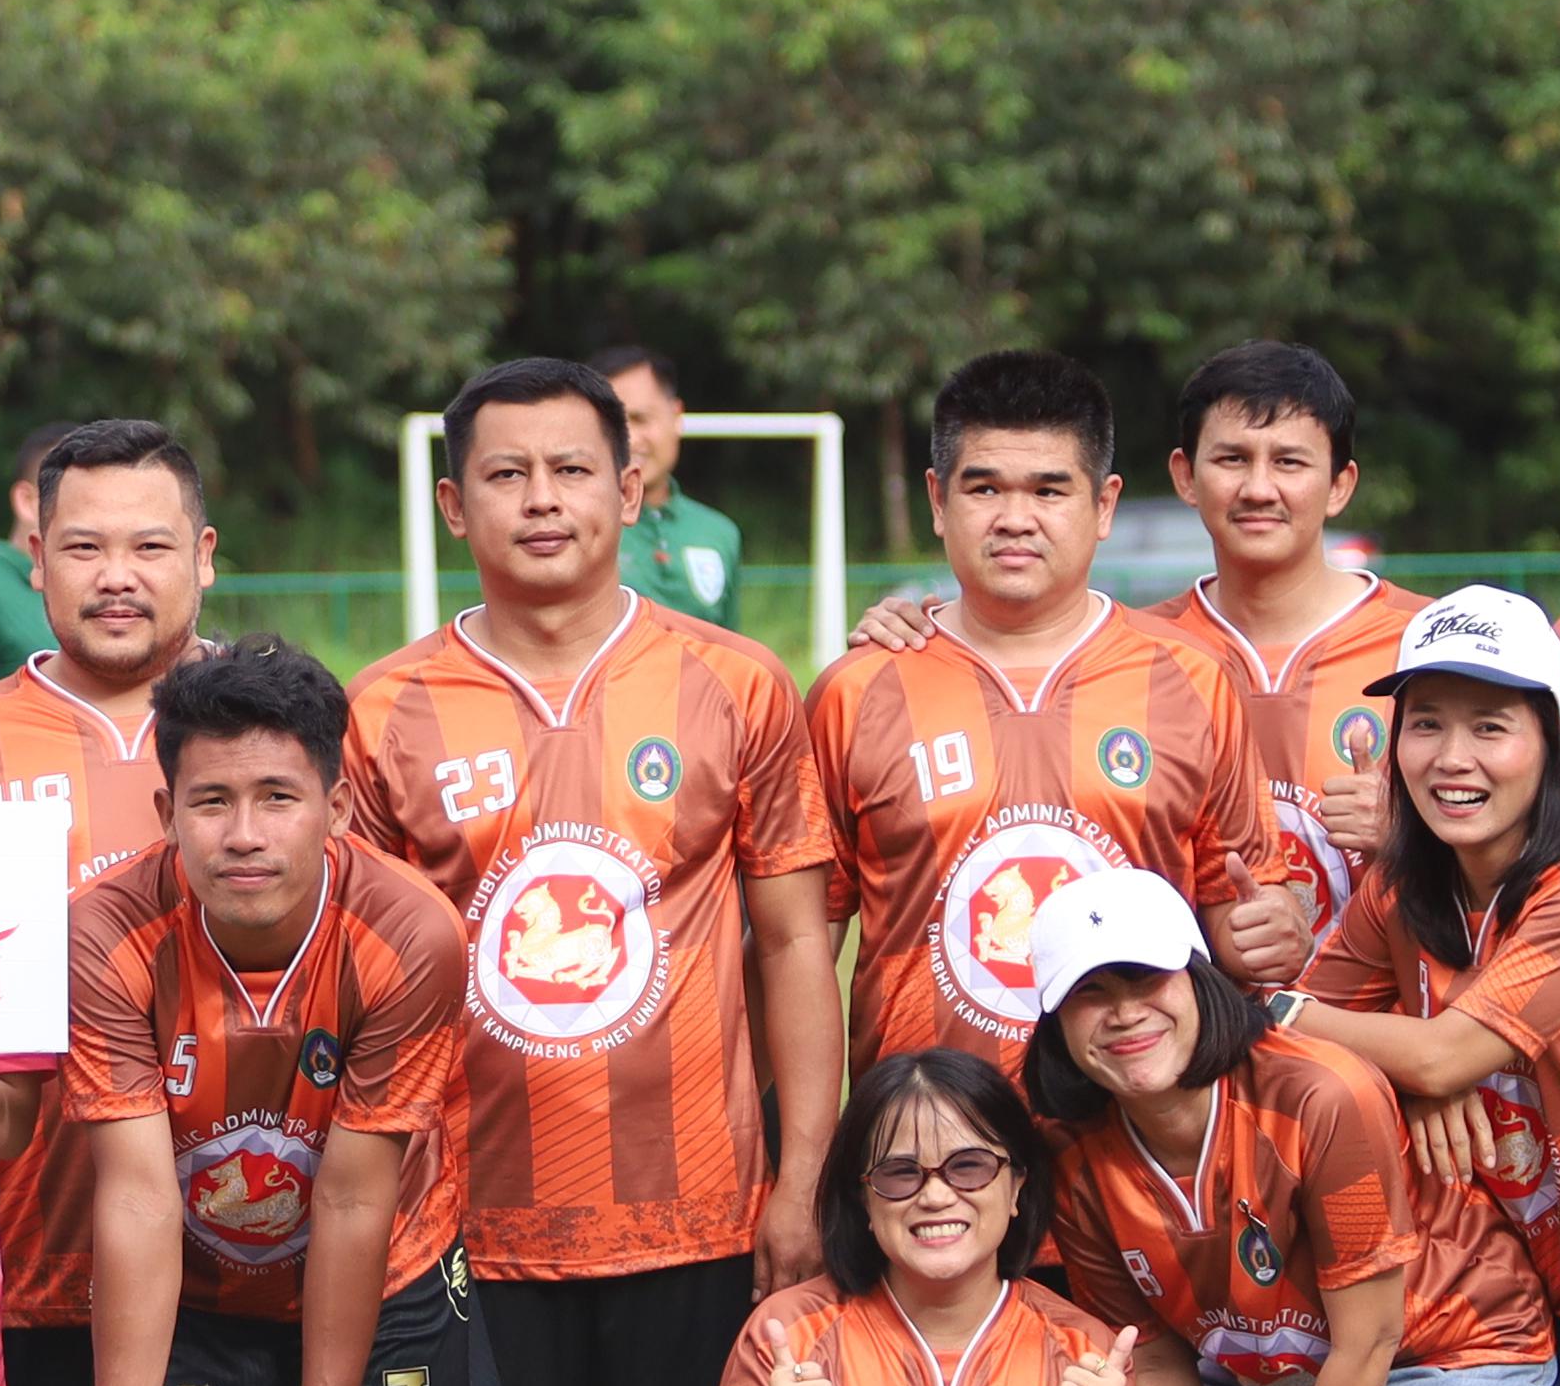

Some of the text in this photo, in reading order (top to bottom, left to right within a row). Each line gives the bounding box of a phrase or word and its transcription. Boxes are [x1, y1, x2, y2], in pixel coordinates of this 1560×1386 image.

[1415, 613, 1503, 649] Athletic
[433, 748, 516, 823] 23
[909, 729, 975, 803] 19
[466, 848, 518, 922] PUBLIC
[482, 1016, 581, 1059] KAMPHAENG
[591, 1022, 634, 1054] PHET
[631, 928, 671, 1027] UNIVERSITY
[166, 1034, 197, 1097] 5
